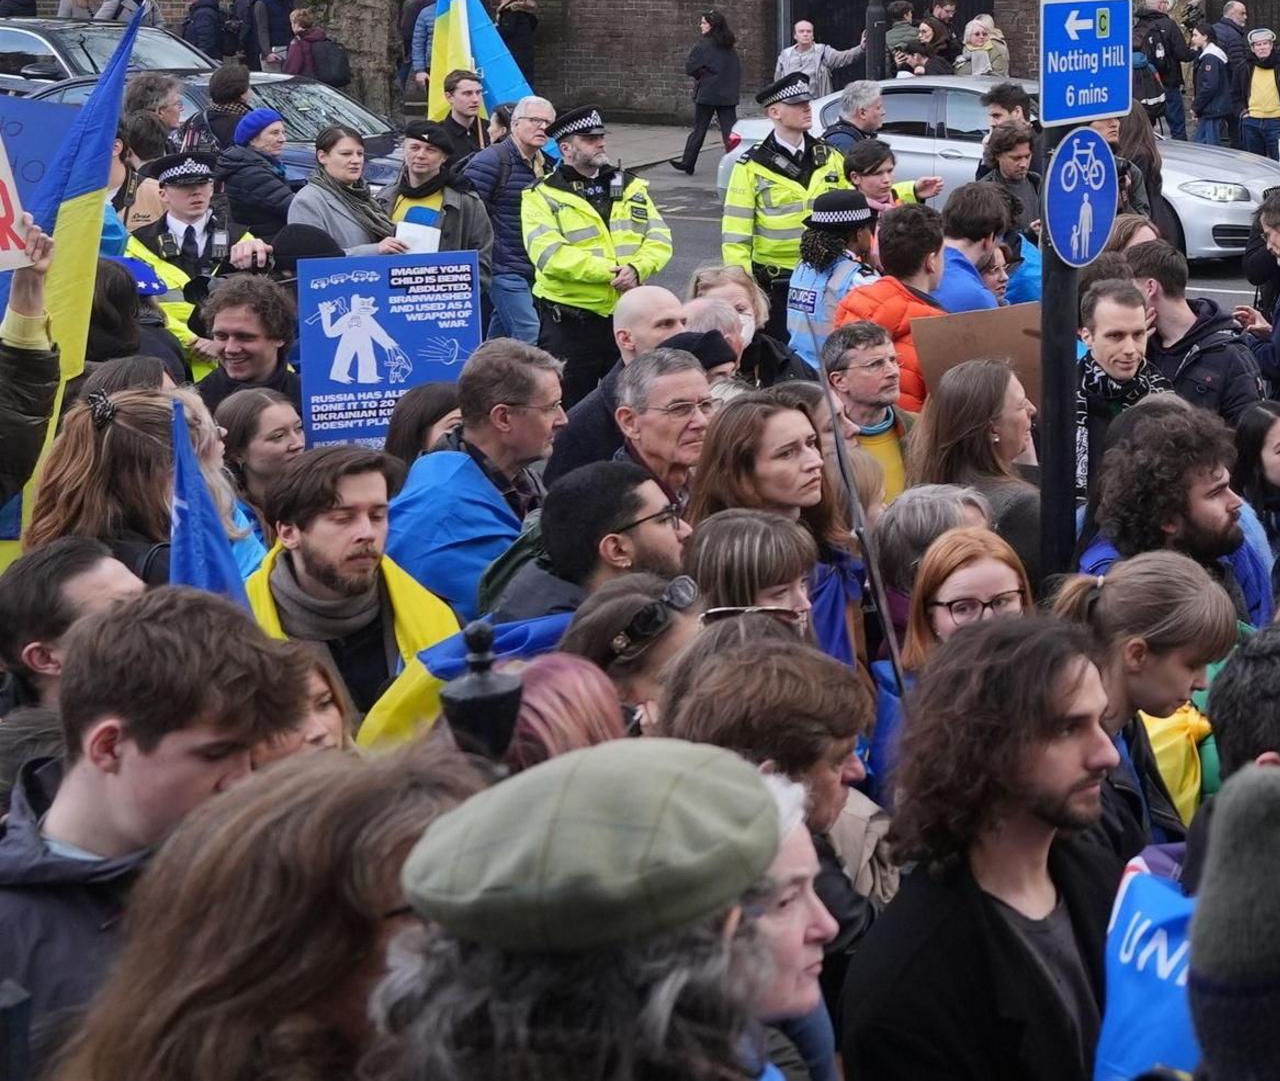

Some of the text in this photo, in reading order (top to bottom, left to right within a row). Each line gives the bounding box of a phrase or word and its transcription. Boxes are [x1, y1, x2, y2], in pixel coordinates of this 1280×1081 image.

[1048, 45, 1125, 74] Notting Hill
[1066, 83, 1108, 107] 6 mins
[391, 264, 471, 276] IMAGINE YOUR
[390, 273, 471, 286] CHILD IS BEING
[388, 292, 472, 304] BRAINWASHED
[390, 301, 472, 313] AND USED AS A
[405, 310, 472, 322] WEAPON OF
[437, 319, 469, 328] WAR.
[311, 393, 355, 404] RUSSIA
[357, 390, 382, 400] HAS
[311, 402, 346, 413] DONE
[347, 401, 359, 409] IT
[360, 400, 378, 409] TO
[312, 409, 377, 422] UKRAINIAN
[312, 419, 365, 431] DOESN'T
